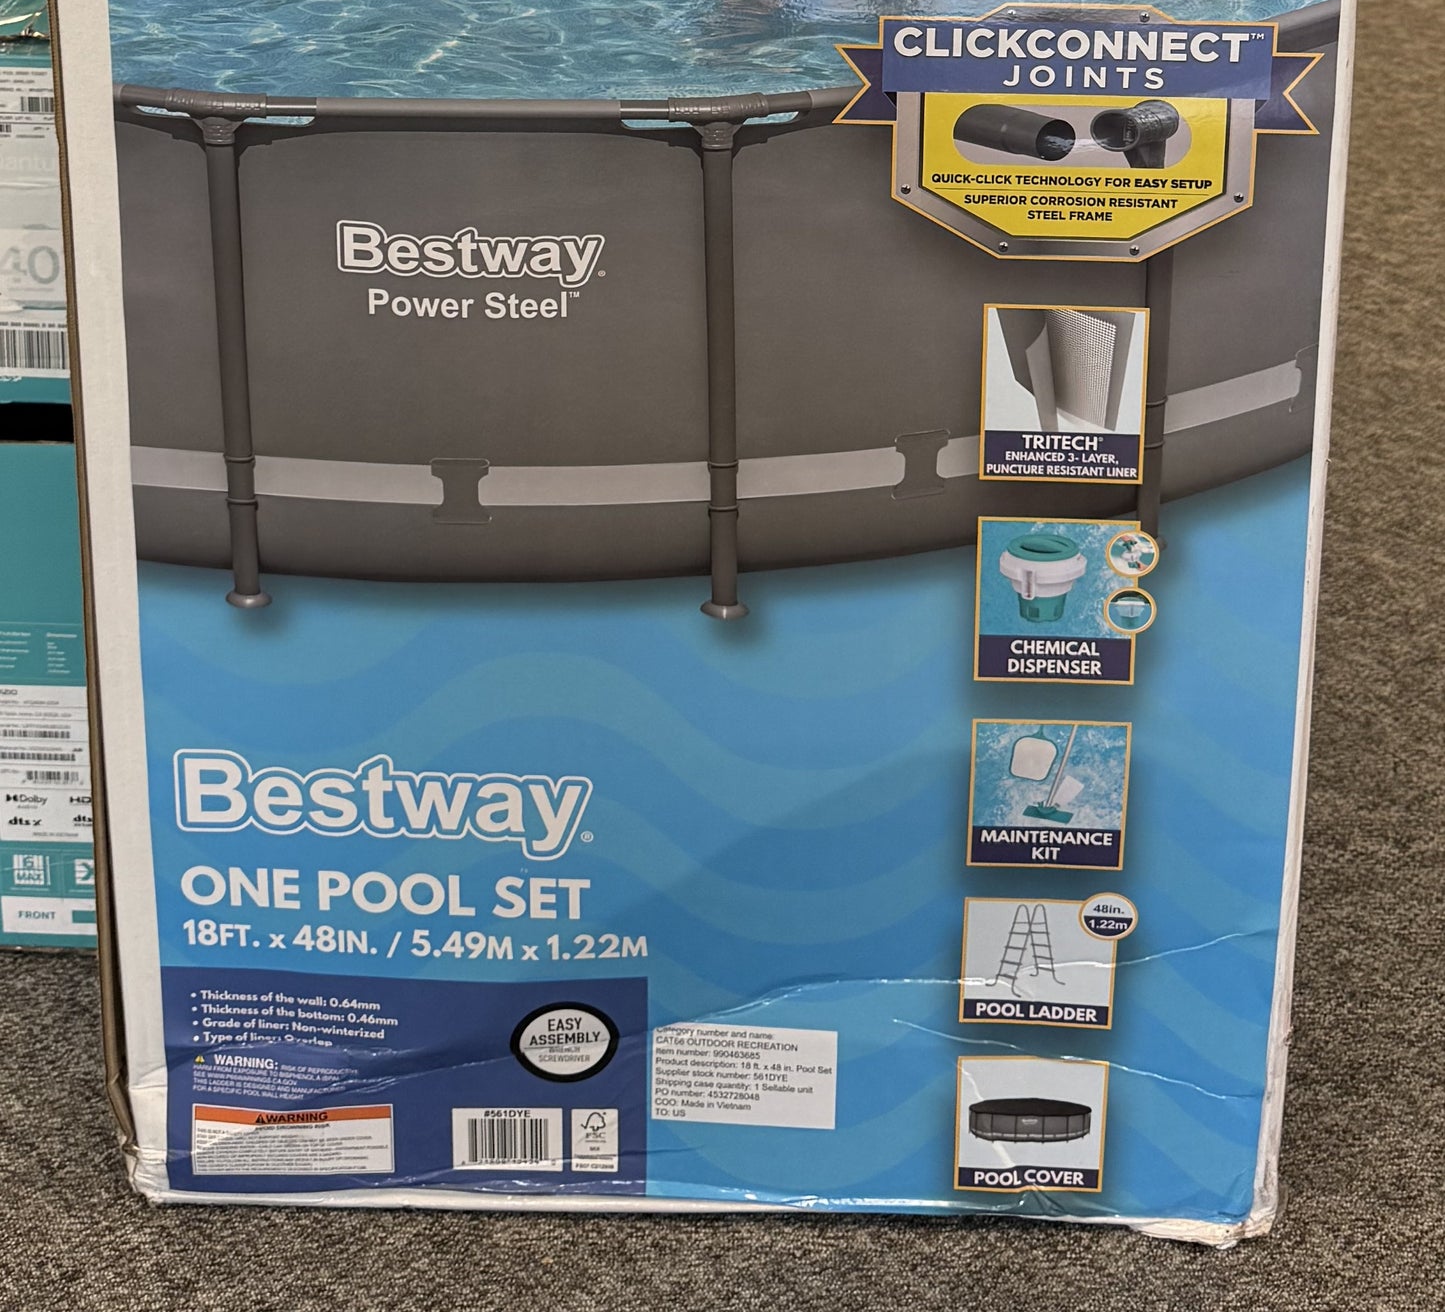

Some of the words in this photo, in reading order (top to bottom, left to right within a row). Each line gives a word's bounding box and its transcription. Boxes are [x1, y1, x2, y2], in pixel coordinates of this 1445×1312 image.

[1002, 65, 1165, 89] JOINTS
[931, 173, 1012, 186] QUICK-CLICK
[1015, 175, 1102, 188] TECHNOLOGY
[1105, 177, 1131, 188] FOR
[1134, 178, 1168, 189] EASY
[1171, 178, 1213, 190] SETUP
[964, 194, 1027, 206] SUPERIOR
[1030, 195, 1107, 208] CORROSION
[1109, 197, 1178, 209] RESISTANT
[1027, 210, 1066, 221] STEEL
[1069, 210, 1113, 222] FRAME
[368, 288, 474, 319] Power
[1005, 451, 1066, 463] ENHANCED
[1081, 453, 1119, 465] LAYER,
[986, 463, 1045, 475] PUNCTURE
[1046, 465, 1104, 477] RESISTANT
[1106, 467, 1138, 478] LINER
[1009, 639, 1100, 656] CHEMICAL
[1007, 657, 1102, 676] DISPENSER
[19, 794, 48, 805] Dolby
[980, 829, 1113, 846] MAINTENANCE
[1031, 846, 1061, 860] KIT
[180, 864, 301, 910] ONE
[317, 869, 476, 917] POOL
[492, 874, 592, 920] SET
[18, 910, 56, 920] FRONT
[1092, 903, 1125, 914] 48in.
[1088, 918, 1128, 931] 1.22m
[182, 919, 260, 948] 18FT.
[268, 932, 287, 949] x
[292, 924, 378, 955] 48IN.
[410, 929, 514, 960] 5.49M
[520, 942, 540, 961] x
[545, 934, 649, 960] 1.22M
[200, 989, 259, 1002] Thickness
[260, 992, 274, 1002] of
[275, 992, 295, 1004] the
[297, 996, 327, 1007] wall:
[329, 997, 381, 1011] 0.64mm
[201, 1003, 260, 1016] Thickness
[261, 1005, 275, 1016] of
[276, 1006, 296, 1018] the
[297, 1008, 345, 1023] bottom:
[347, 1012, 399, 1026] 0.46mm
[975, 1002, 1024, 1018] POOL
[1028, 1004, 1098, 1023] LADDER
[202, 1017, 241, 1028] Grade
[243, 1018, 256, 1029] of
[258, 1019, 290, 1030] liner:
[292, 1021, 385, 1039] Non-winterized
[548, 1016, 582, 1032] EASY
[203, 1031, 233, 1044] Type
[235, 1032, 248, 1042] of
[529, 1031, 601, 1046] ASSEMBLY
[696, 1029, 729, 1037] number
[730, 1030, 747, 1038] and
[655, 1047, 675, 1055] Item
[676, 1049, 711, 1057] number:
[687, 1038, 735, 1048] OUTDOOR
[737, 1040, 799, 1052] RECREATION
[213, 1054, 279, 1070] WARNING:
[655, 1057, 688, 1066] Product
[690, 1059, 738, 1069] description:
[741, 1061, 751, 1069] 18
[770, 1063, 782, 1072] 48
[796, 1065, 816, 1073] Pool
[817, 1066, 833, 1075] Set
[655, 1067, 690, 1077] Supplier
[692, 1069, 714, 1078] stock
[716, 1071, 751, 1080] number:
[753, 1072, 788, 1083] 561DYE
[655, 1077, 692, 1088] Shipping
[693, 1080, 714, 1089] case
[797, 1086, 814, 1094] unit
[655, 1088, 669, 1096] PO
[671, 1089, 705, 1098] number:
[681, 1099, 705, 1108] Made
[707, 1101, 715, 1109] in
[716, 1101, 752, 1111] Vietnam
[266, 1111, 329, 1124] WARNING
[672, 1109, 686, 1117] US
[973, 1170, 1022, 1186] POOL
[1023, 1168, 1085, 1186] COVER
